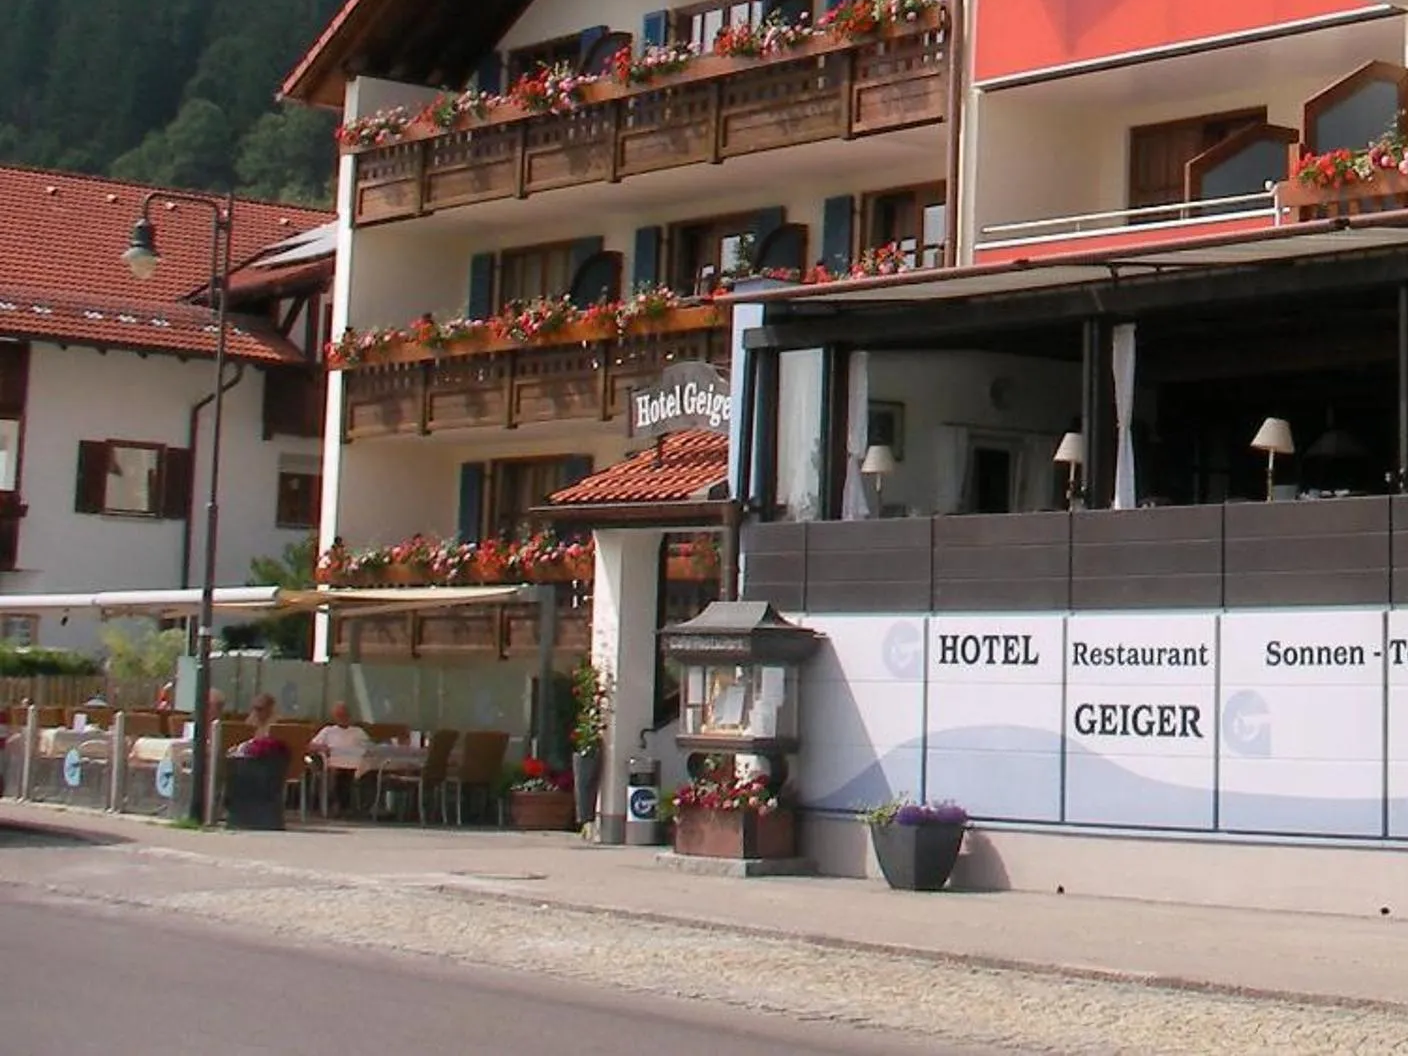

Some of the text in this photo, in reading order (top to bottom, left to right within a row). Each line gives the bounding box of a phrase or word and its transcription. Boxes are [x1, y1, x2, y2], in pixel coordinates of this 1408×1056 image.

[636, 382, 732, 427] Hotel Geige
[939, 634, 1039, 665] HOTEL
[1073, 642, 1208, 666] Restaurant
[1074, 703, 1204, 738] GEIGER
